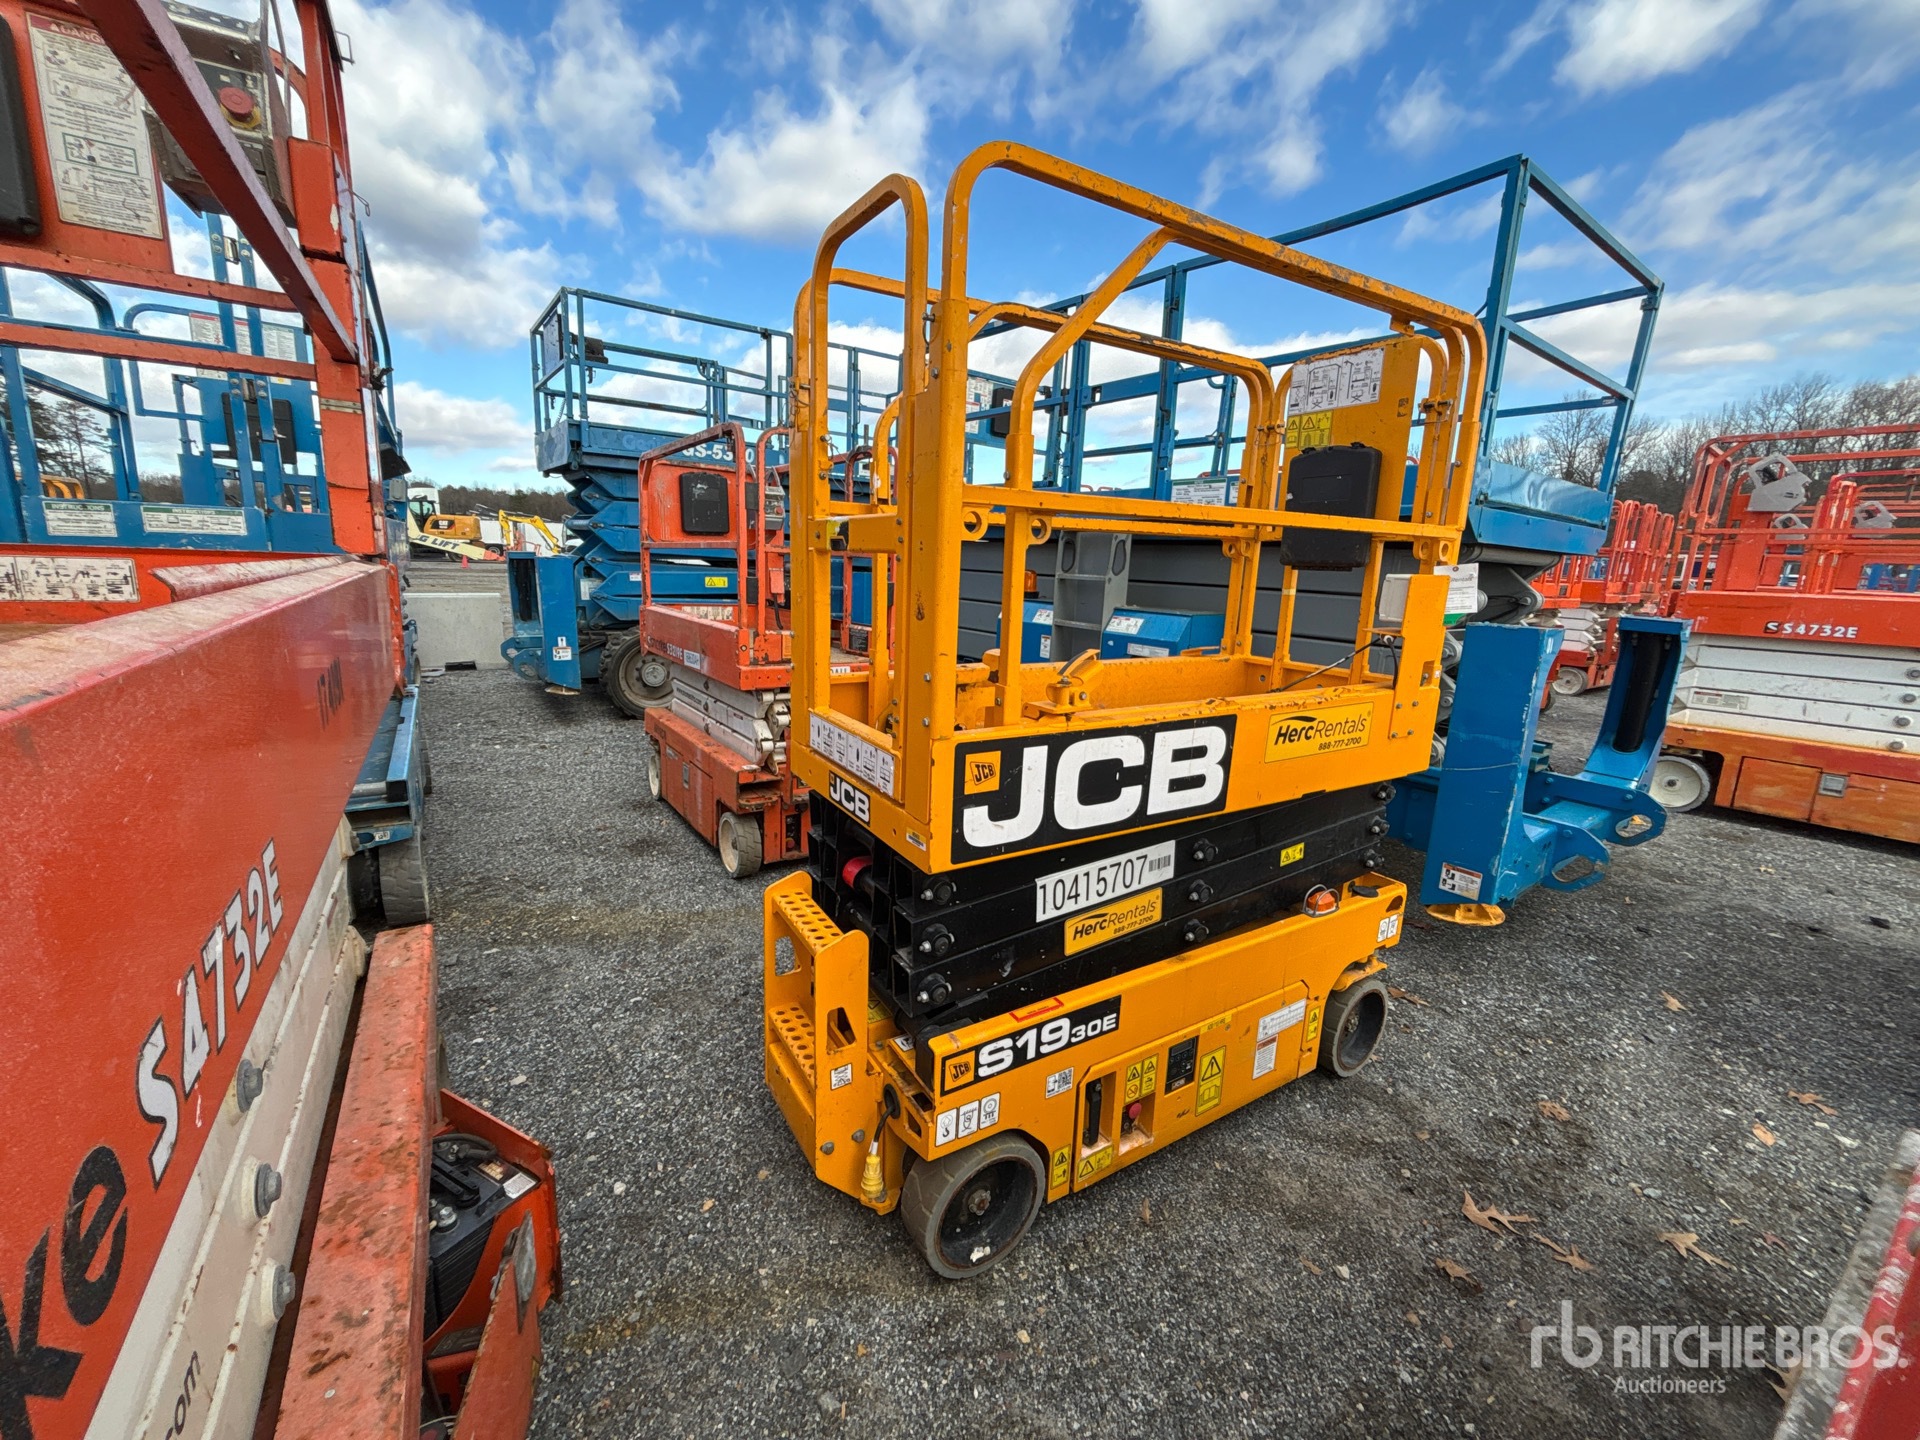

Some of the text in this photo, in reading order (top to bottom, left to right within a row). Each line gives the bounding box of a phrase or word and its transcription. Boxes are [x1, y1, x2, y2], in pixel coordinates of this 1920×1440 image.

[683, 443, 755, 463] GS-530
[1782, 622, 1858, 639] S4732E
[1274, 714, 1368, 745] HercRentals
[1318, 736, 1362, 751] 888-777-2700
[974, 763, 995, 783] JCB
[963, 726, 1226, 848] JCB
[829, 777, 870, 824] JCB
[1039, 854, 1148, 915] 10415707
[1072, 899, 1157, 941] HercRentals
[1113, 915, 1154, 935] 888-777-2700
[951, 1062, 970, 1080] JCB
